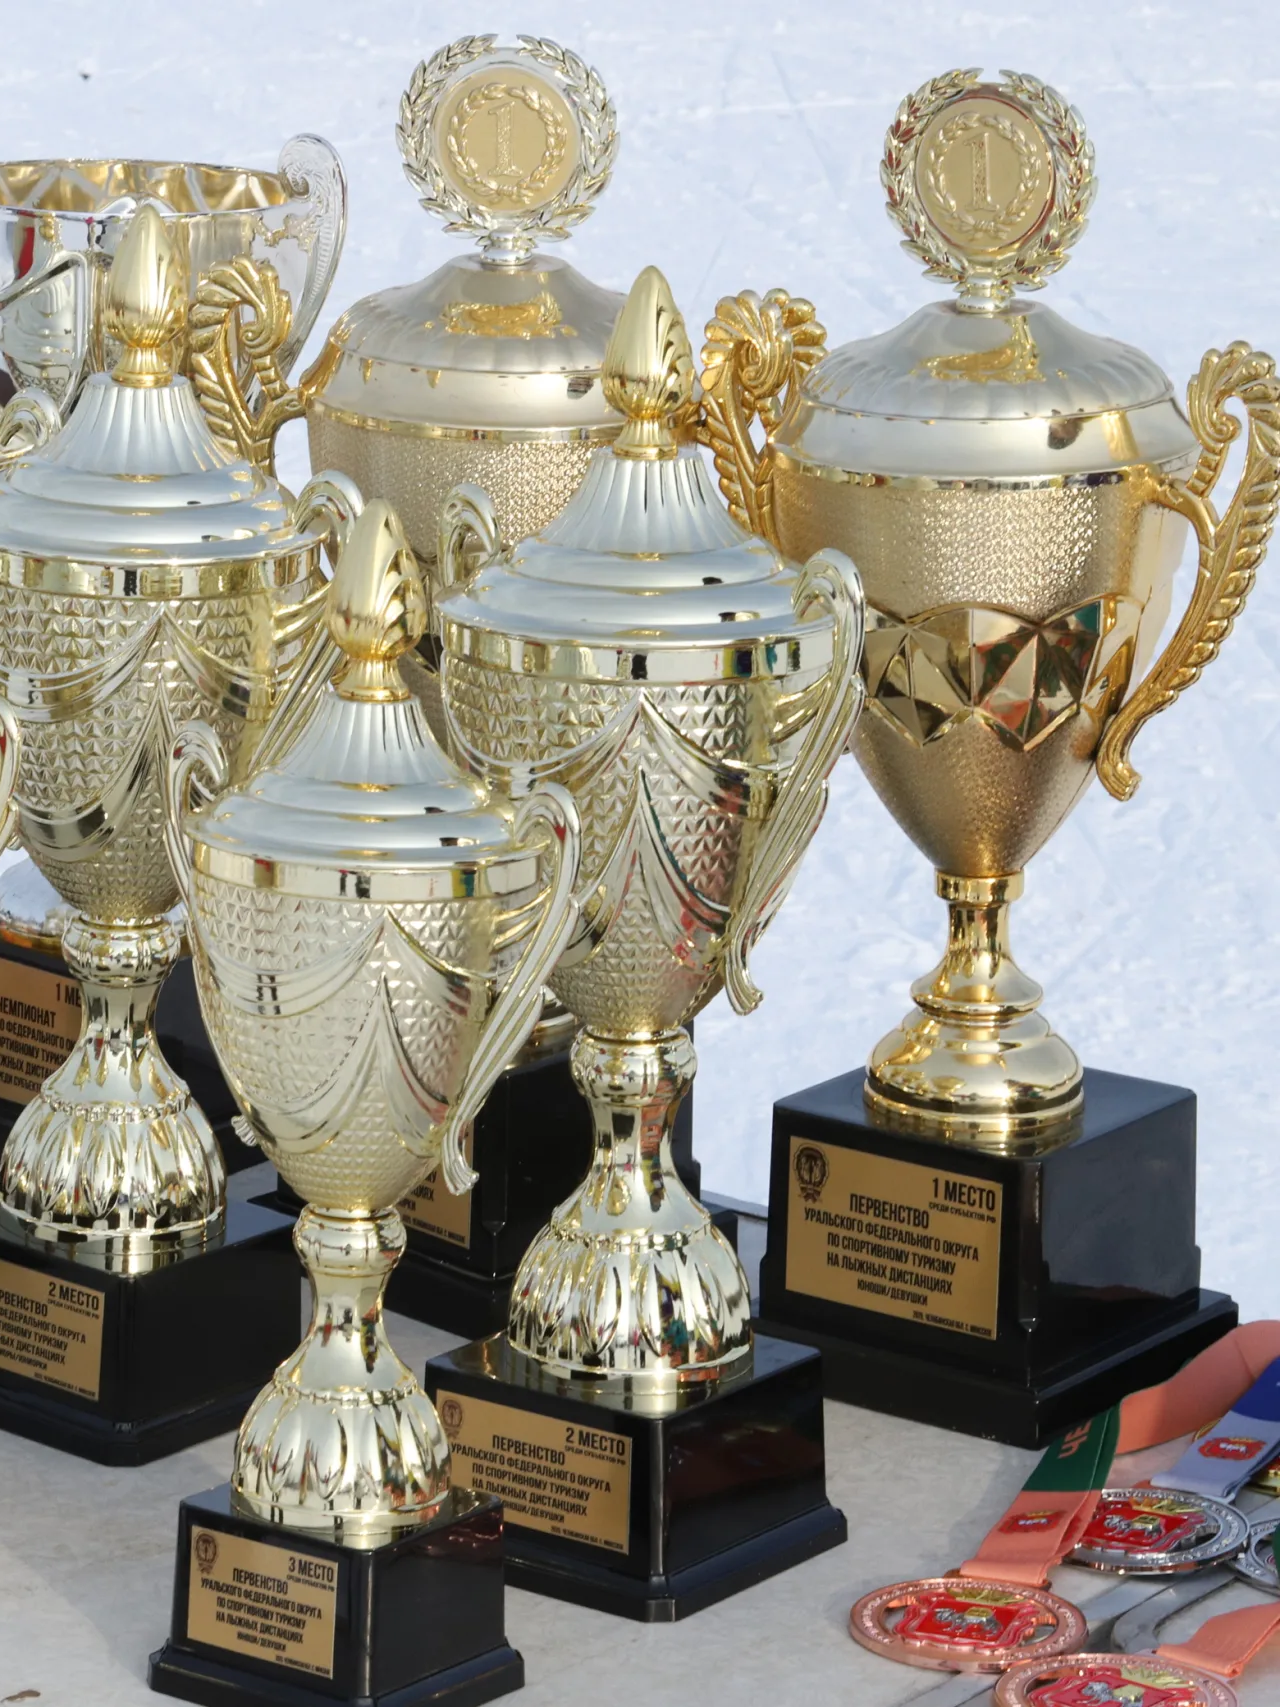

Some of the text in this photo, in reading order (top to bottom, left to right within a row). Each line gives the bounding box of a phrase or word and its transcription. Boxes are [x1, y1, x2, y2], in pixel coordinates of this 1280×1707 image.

[487, 101, 523, 176] 1
[962, 131, 1000, 212] 1
[56, 983, 60, 1002] 1
[6, 1022, 64, 1048] ФЕДЕРАЛЬНОГО
[41, 1048, 66, 1065] ТУРИЗ
[14, 1076, 42, 1093] СУБЪЕКТ
[849, 1192, 930, 1230] ПЕРВЕНСТВО
[931, 1176, 996, 1212] 1 МЕСТО
[804, 1206, 979, 1262] УРАЛЬСКОГО ФЕДЕРАЛЬНОГО ОКРУГА
[826, 1231, 956, 1276] ПО СПОРТИВНОМУ ТУРИЗМУ
[826, 1251, 952, 1296] НА ЛЫЖНЫХ ДИСТАНЦИЯХ
[48, 1280, 100, 1312] 2 МЕСТО
[856, 1278, 928, 1308] ЮНОШИ/ДЕВУШКИ
[33, 1331, 68, 1353] ТУРИЗМУ
[57, 1325, 86, 1344] ОКРУГА
[14, 1339, 65, 1366] ДИСТАНЦИЯХ
[491, 1433, 566, 1466] ПЕРВЕНСТВО
[565, 1426, 625, 1457] 2 МЕСТО
[450, 1441, 611, 1493] УРАЛЬСКОГО ФЕДЕРАЛЬНОГО ОКРУГА
[471, 1461, 590, 1503] ПО СПОРТИВНОМУ ТУРИЗМУ
[471, 1476, 587, 1518] НА ЛЫЖНЫХ ДИСТАНЦИЯХ
[232, 1567, 288, 1596] ПЕРВЕНСТВО
[288, 1556, 334, 1584] 3 МЕСТО
[200, 1576, 322, 1620] УРАЛЬСКОГО ФЕДЕРАЛЬНОГО ОКРУГА
[216, 1595, 306, 1631] ПО СПОРТИВНОМУ ТУРИЗМУ
[215, 1609, 304, 1646] НА ЛЫЖНЫХ ДИСТАНЦИЯХ
